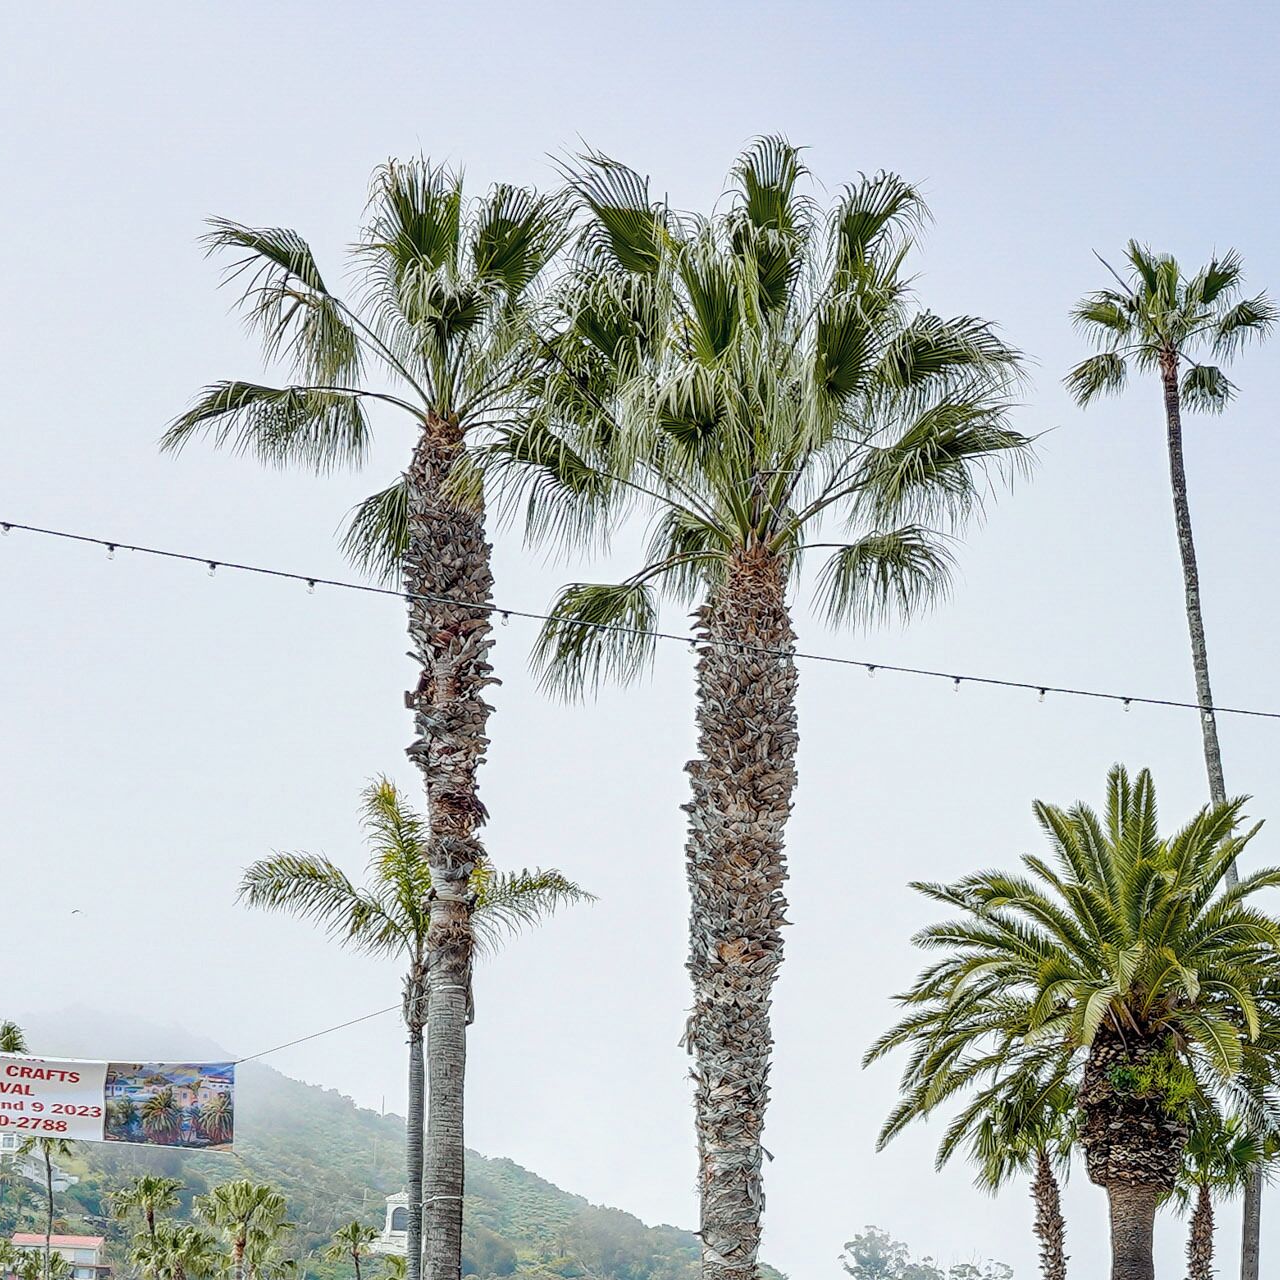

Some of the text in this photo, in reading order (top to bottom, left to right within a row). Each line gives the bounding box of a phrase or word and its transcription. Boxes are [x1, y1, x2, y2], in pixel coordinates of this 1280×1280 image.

[6, 1065, 81, 1083] CRAFTS
[31, 1102, 45, 1113] 9
[51, 1103, 102, 1118] 2023
